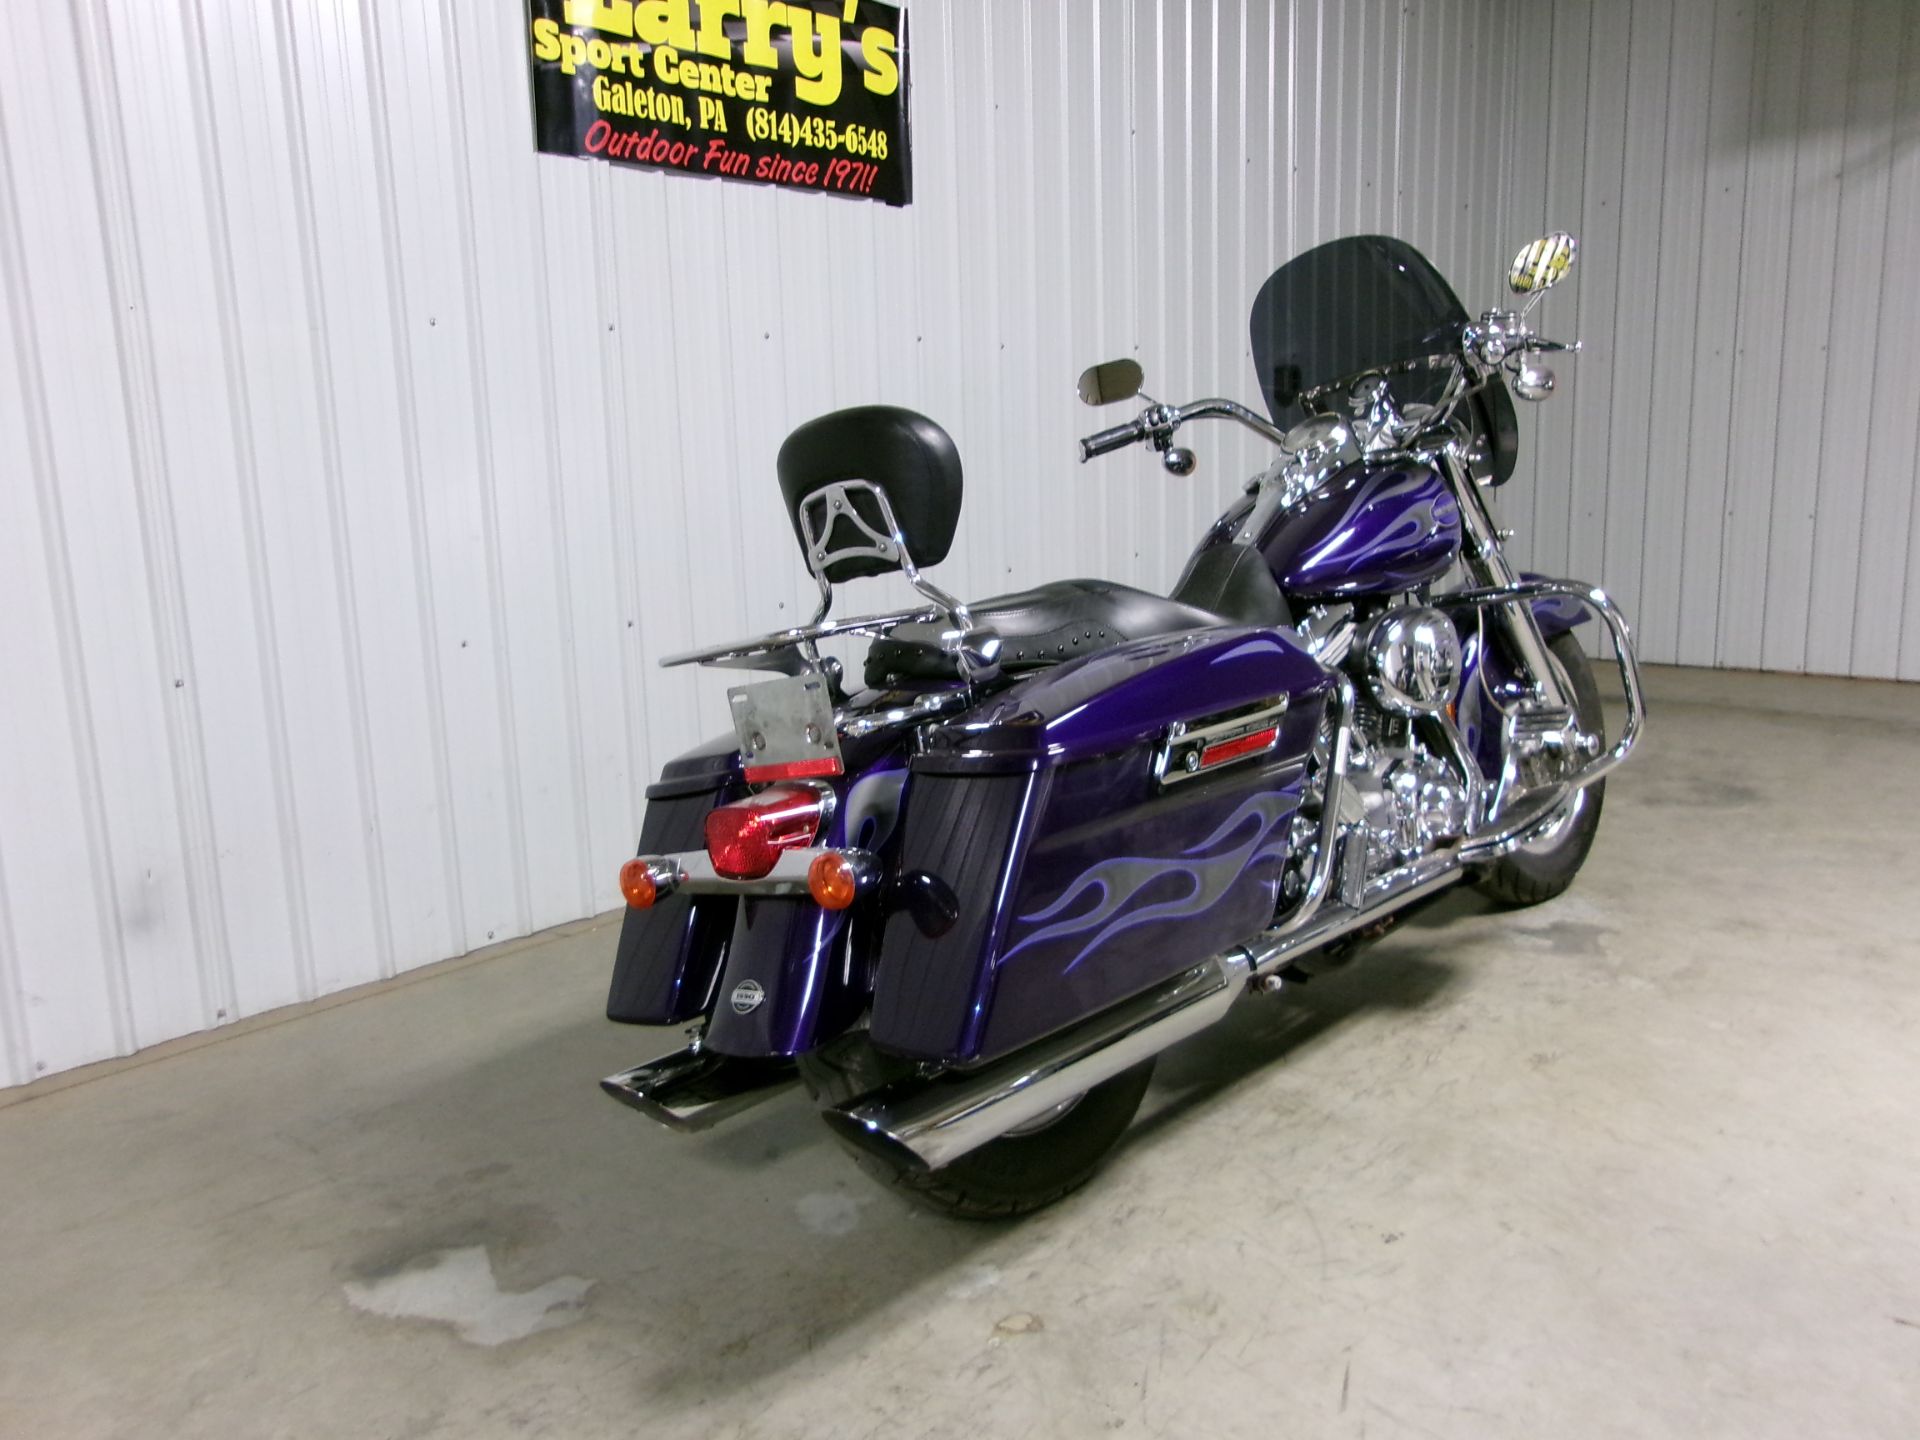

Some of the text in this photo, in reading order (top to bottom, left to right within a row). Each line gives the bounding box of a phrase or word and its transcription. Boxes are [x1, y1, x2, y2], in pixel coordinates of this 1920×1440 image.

[534, 18, 772, 102] Sport Center
[592, 75, 728, 133] Galeton, PA
[746, 107, 888, 160] (814)435-6548
[584, 119, 878, 193] Outdoor Fun since 1971!
